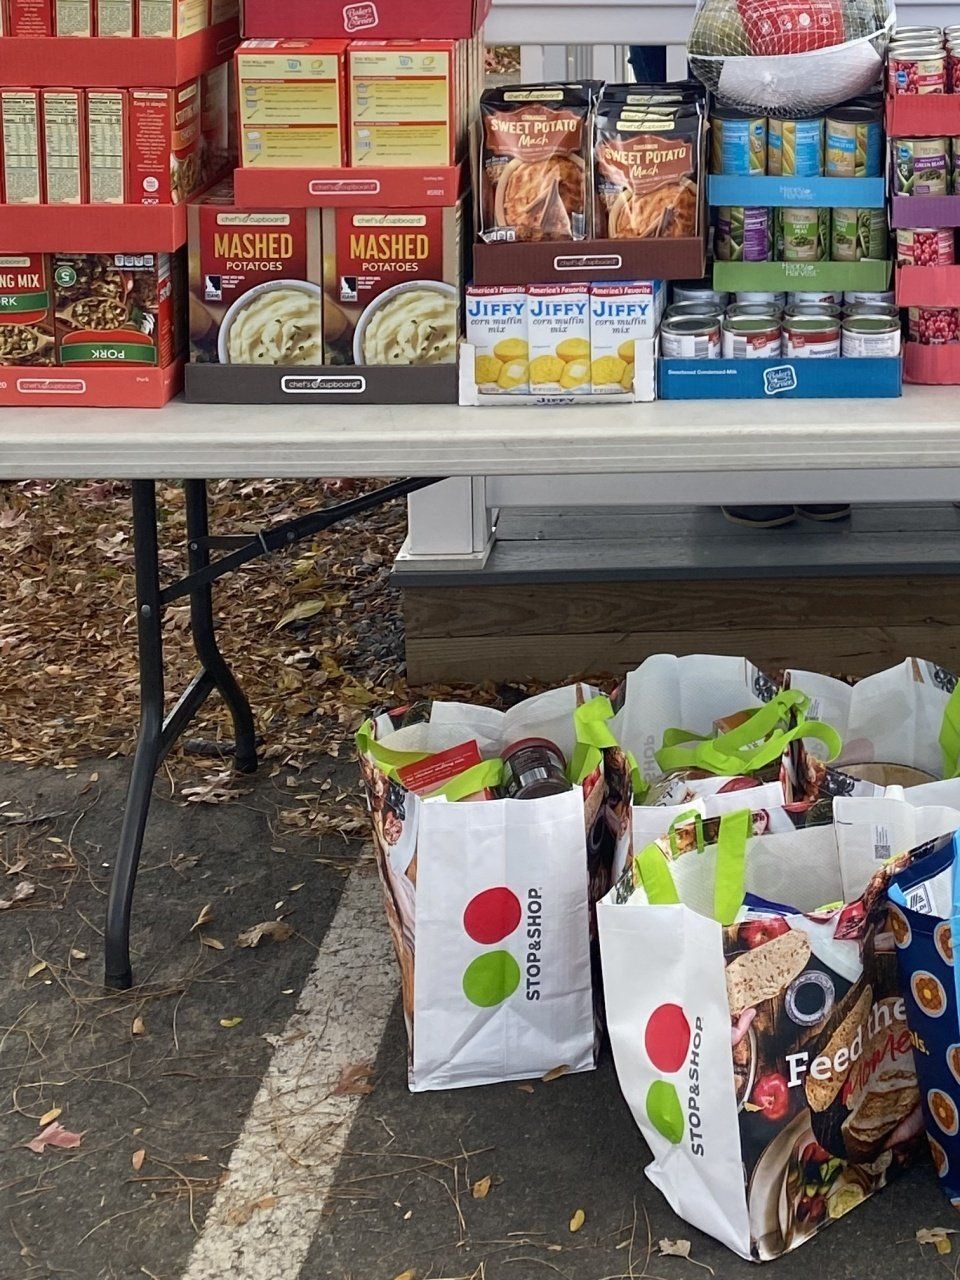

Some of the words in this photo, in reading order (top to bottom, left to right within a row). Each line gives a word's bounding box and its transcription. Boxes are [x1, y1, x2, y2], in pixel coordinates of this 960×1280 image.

[491, 120, 529, 134] SWEET
[534, 119, 577, 134] POTATO
[605, 148, 641, 164] SWEET
[645, 147, 686, 163] POTATO
[250, 216, 285, 224] cupboard
[214, 232, 293, 259] MASHED
[350, 234, 429, 260] MASHED
[226, 261, 283, 271] POTATOES
[362, 262, 419, 272] POTATOES
[782, 263, 809, 271] Happy
[62, 271, 71, 281] 5
[786, 269, 817, 277] Harvest
[18, 274, 40, 288] MIX
[467, 286, 499, 294] America's
[499, 286, 525, 294] Favorite
[529, 286, 560, 294] America's
[561, 286, 588, 294] Favorite
[624, 286, 651, 294] Favorite
[0, 297, 17, 306] RK
[468, 301, 525, 317] JIFFY
[530, 301, 587, 317] JIFFY
[593, 302, 650, 317] JIFFY
[493, 317, 522, 325] muffin
[555, 317, 584, 325] muffin
[617, 318, 647, 326] muffin
[91, 349, 125, 359] PORK
[320, 379, 358, 390] cupboard
[526, 888, 542, 1001] STOP&SHOP
[785, 1025, 863, 1088] Feed
[867, 997, 907, 1040] the
[688, 1016, 704, 1157] STOP&SHOP
